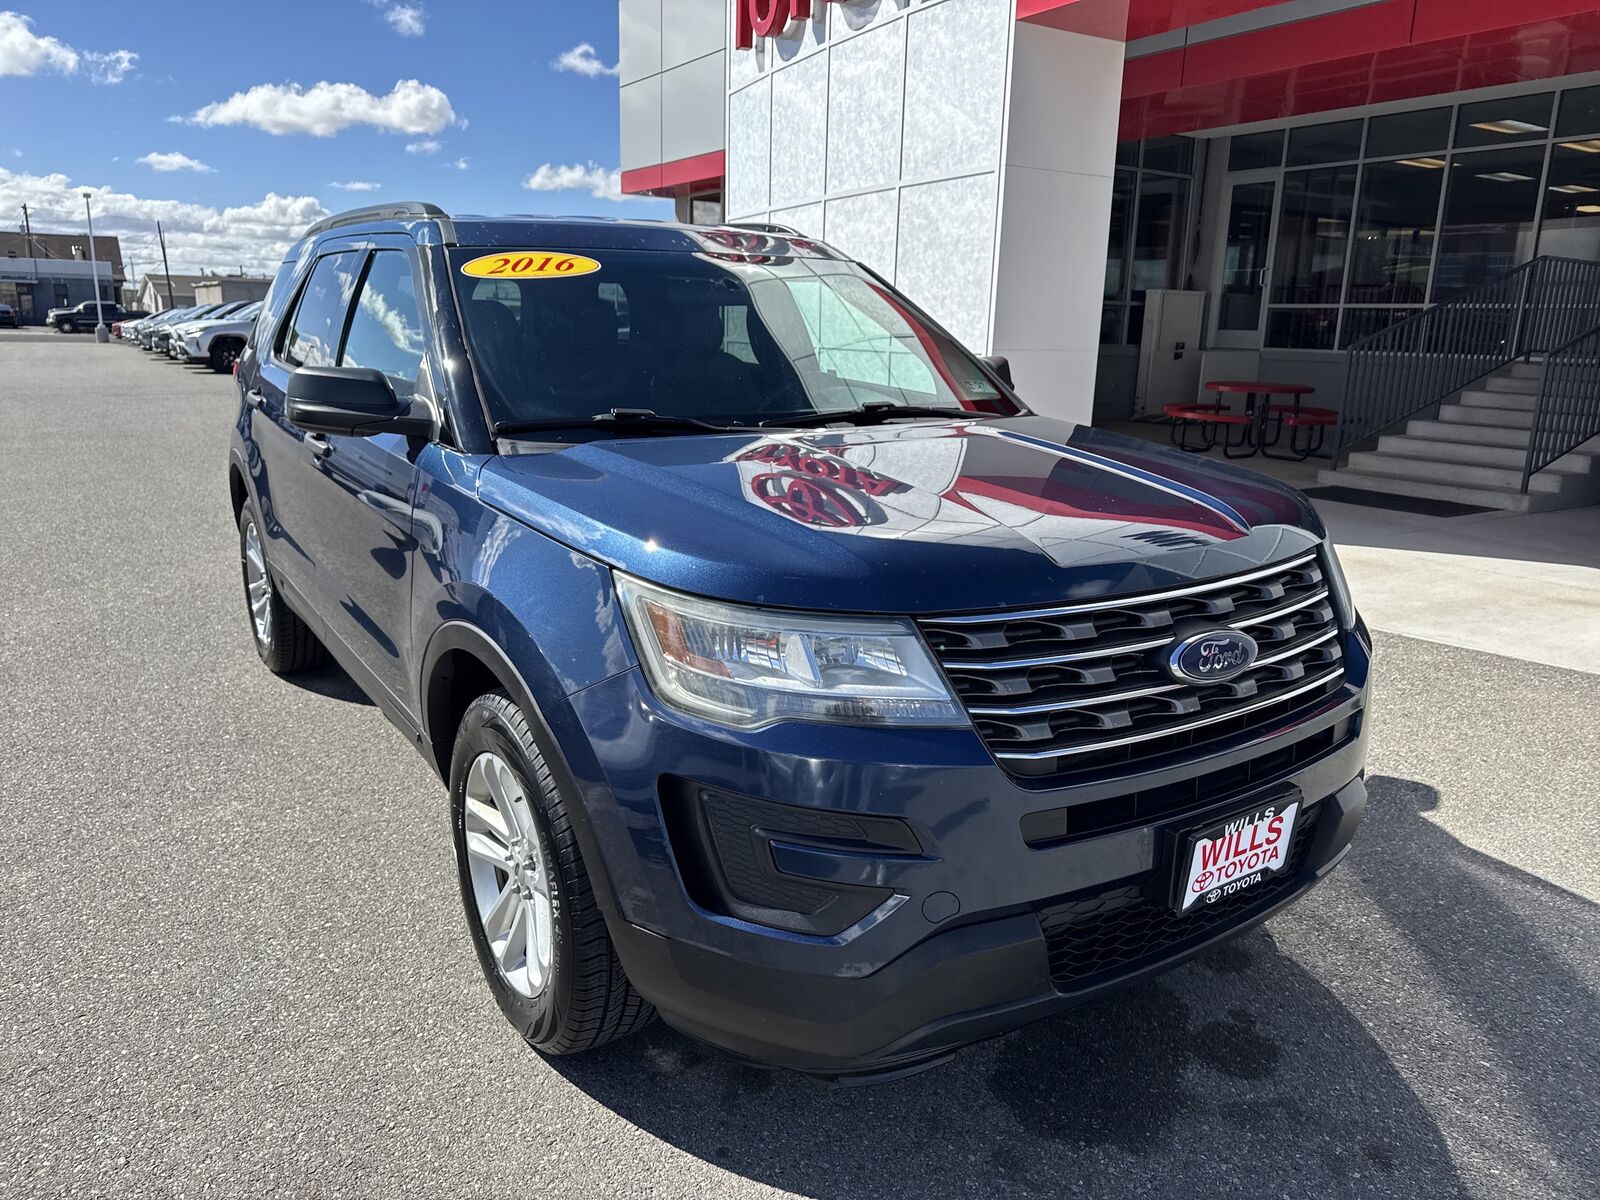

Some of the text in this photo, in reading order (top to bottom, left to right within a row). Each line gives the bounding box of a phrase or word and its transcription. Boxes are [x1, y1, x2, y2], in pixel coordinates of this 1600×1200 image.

[487, 256, 579, 275] 2016
[1199, 638, 1245, 673] Ford
[1224, 806, 1276, 837] WILLS
[1202, 815, 1284, 871] WILLS
[1216, 846, 1280, 882] TOYOTA
[1223, 872, 1262, 897] TOYOTA
